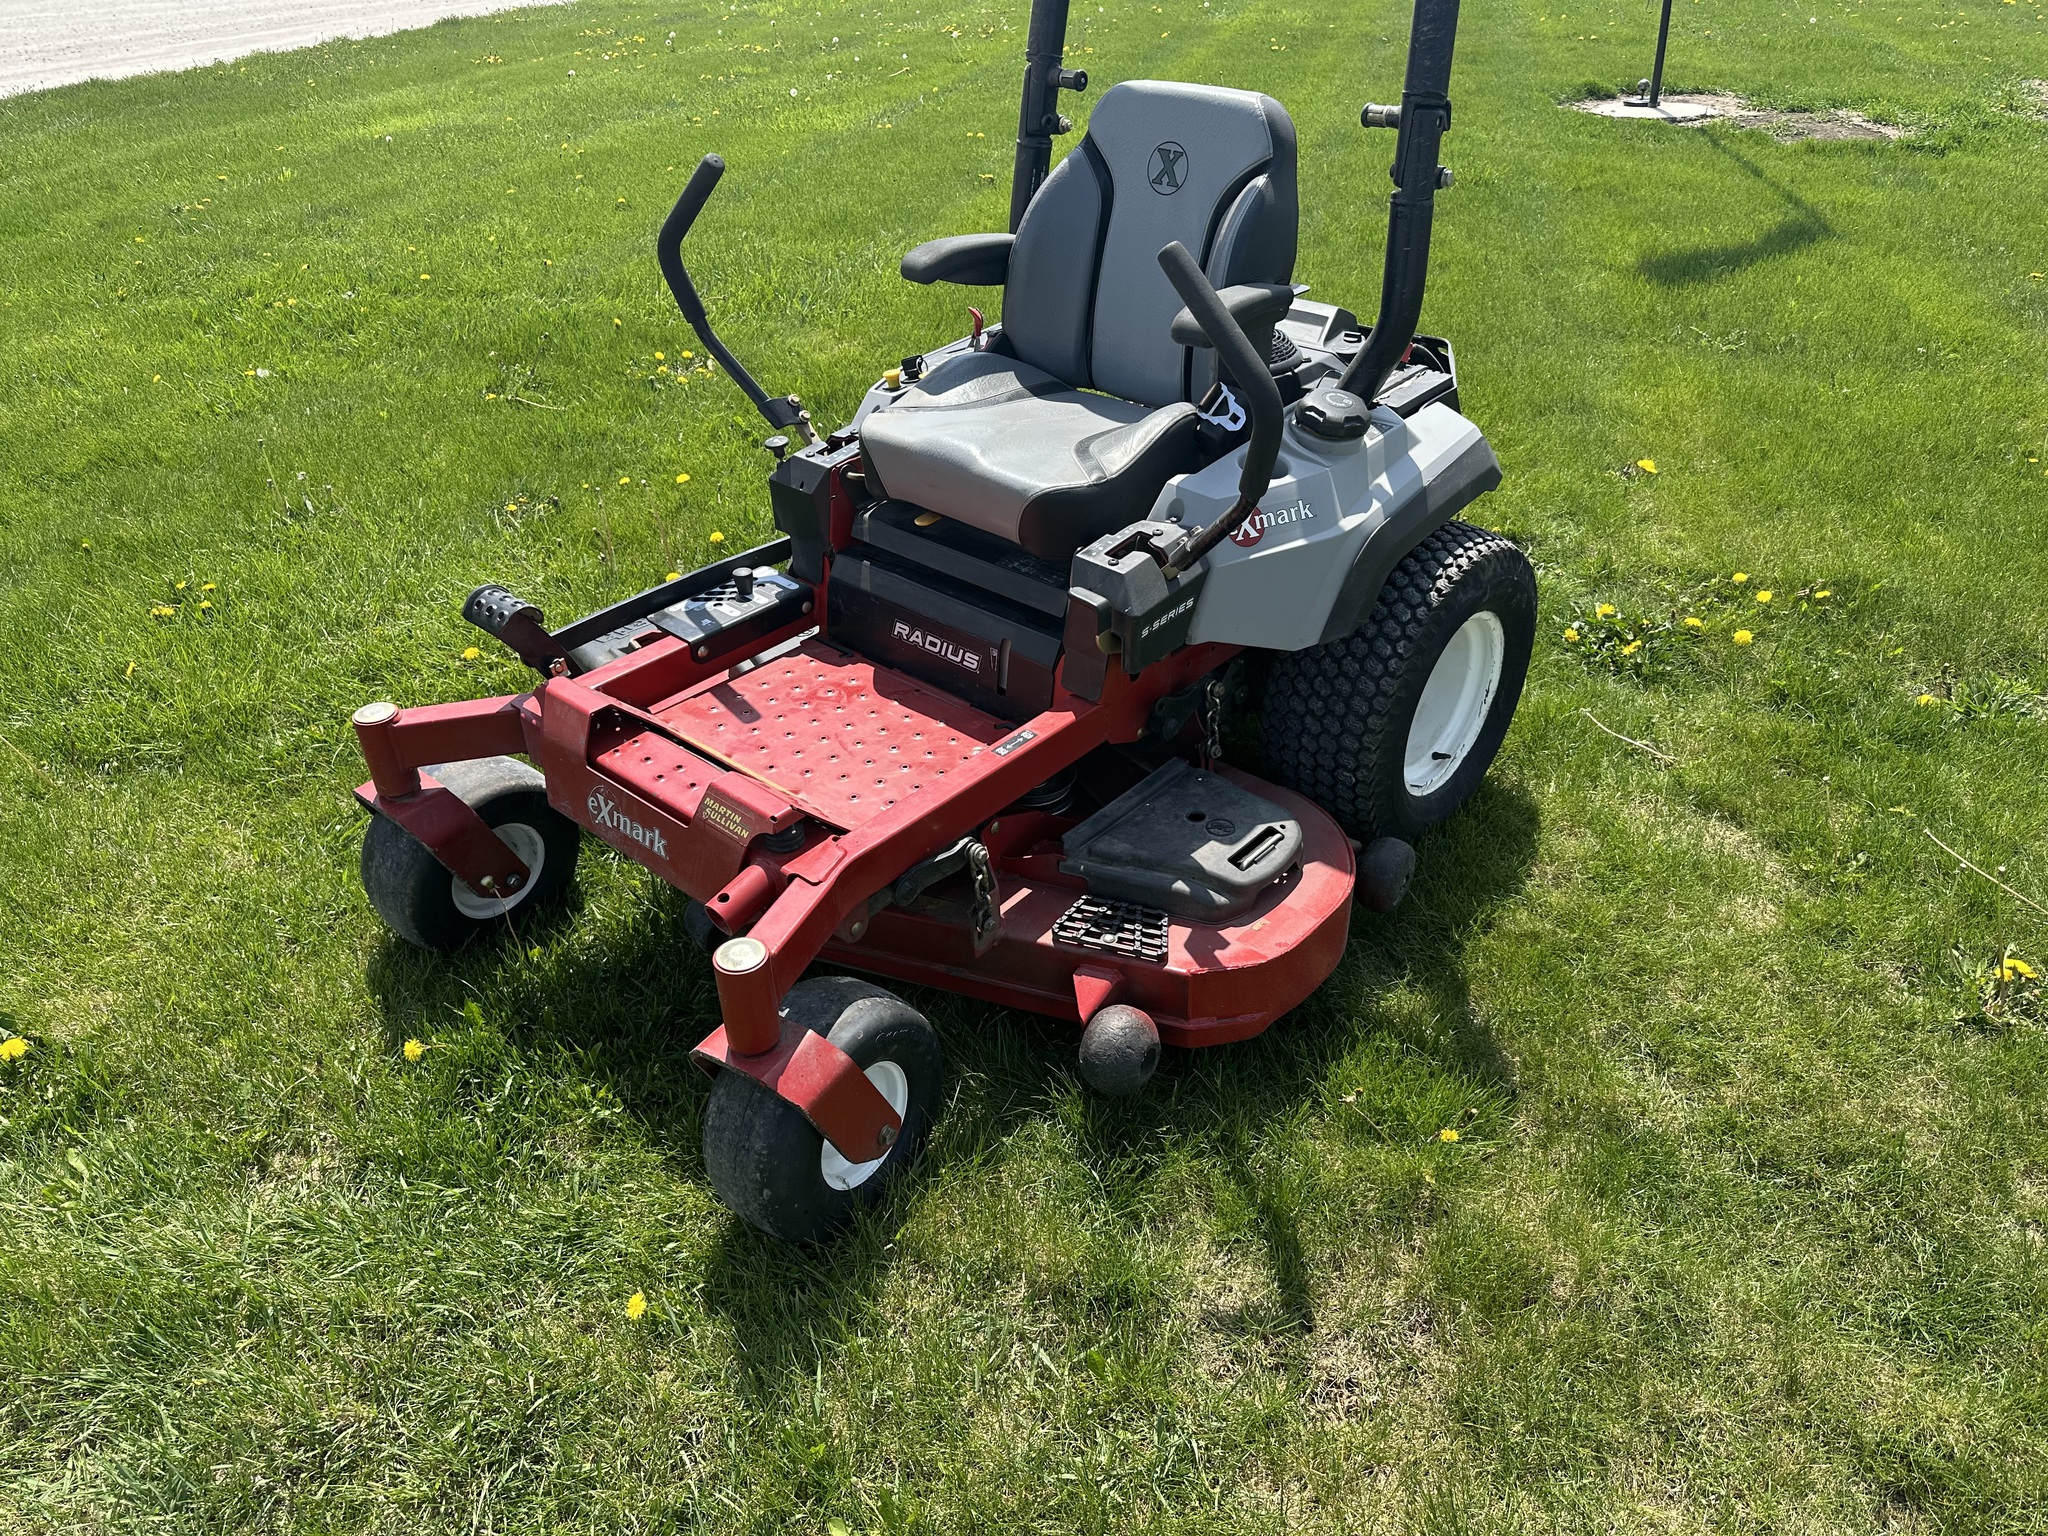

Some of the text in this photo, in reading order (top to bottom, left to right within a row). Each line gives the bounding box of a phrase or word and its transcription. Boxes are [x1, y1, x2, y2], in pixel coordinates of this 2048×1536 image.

[1229, 499, 1314, 541] Xmark
[893, 619, 981, 671] RADIUS
[587, 792, 668, 859] eXmark
[703, 797, 742, 823] MARTIN
[705, 807, 750, 839] SULLIVAN
